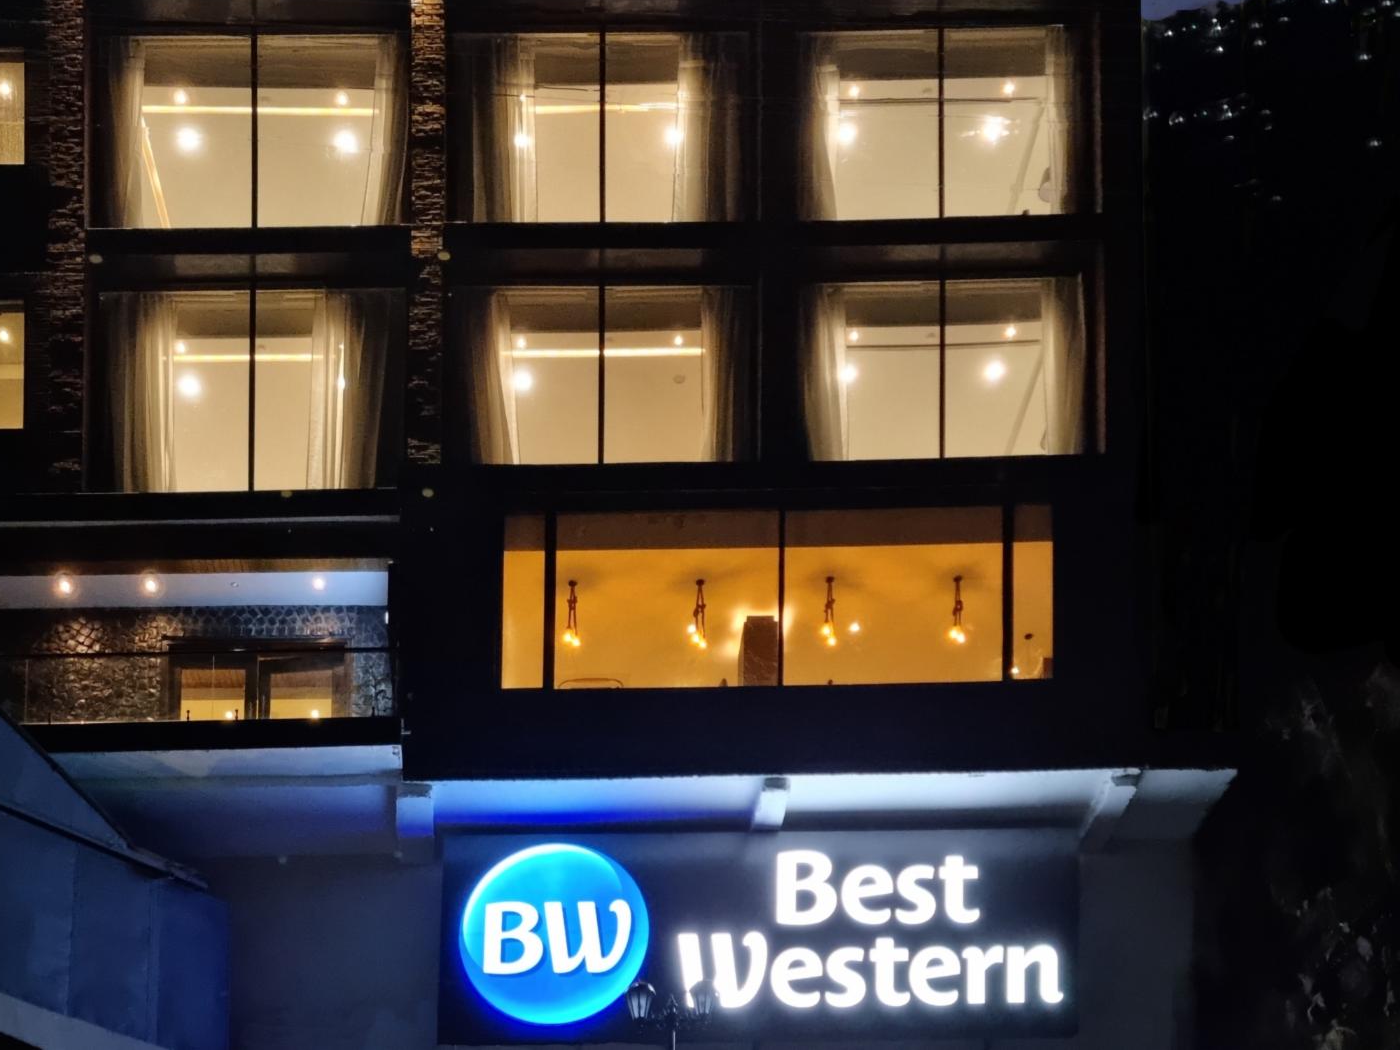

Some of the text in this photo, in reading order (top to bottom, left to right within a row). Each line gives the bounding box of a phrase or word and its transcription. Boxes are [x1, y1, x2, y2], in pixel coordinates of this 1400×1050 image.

[774, 849, 981, 927] Best
[482, 898, 632, 976] BW
[677, 930, 1065, 1009] Western
